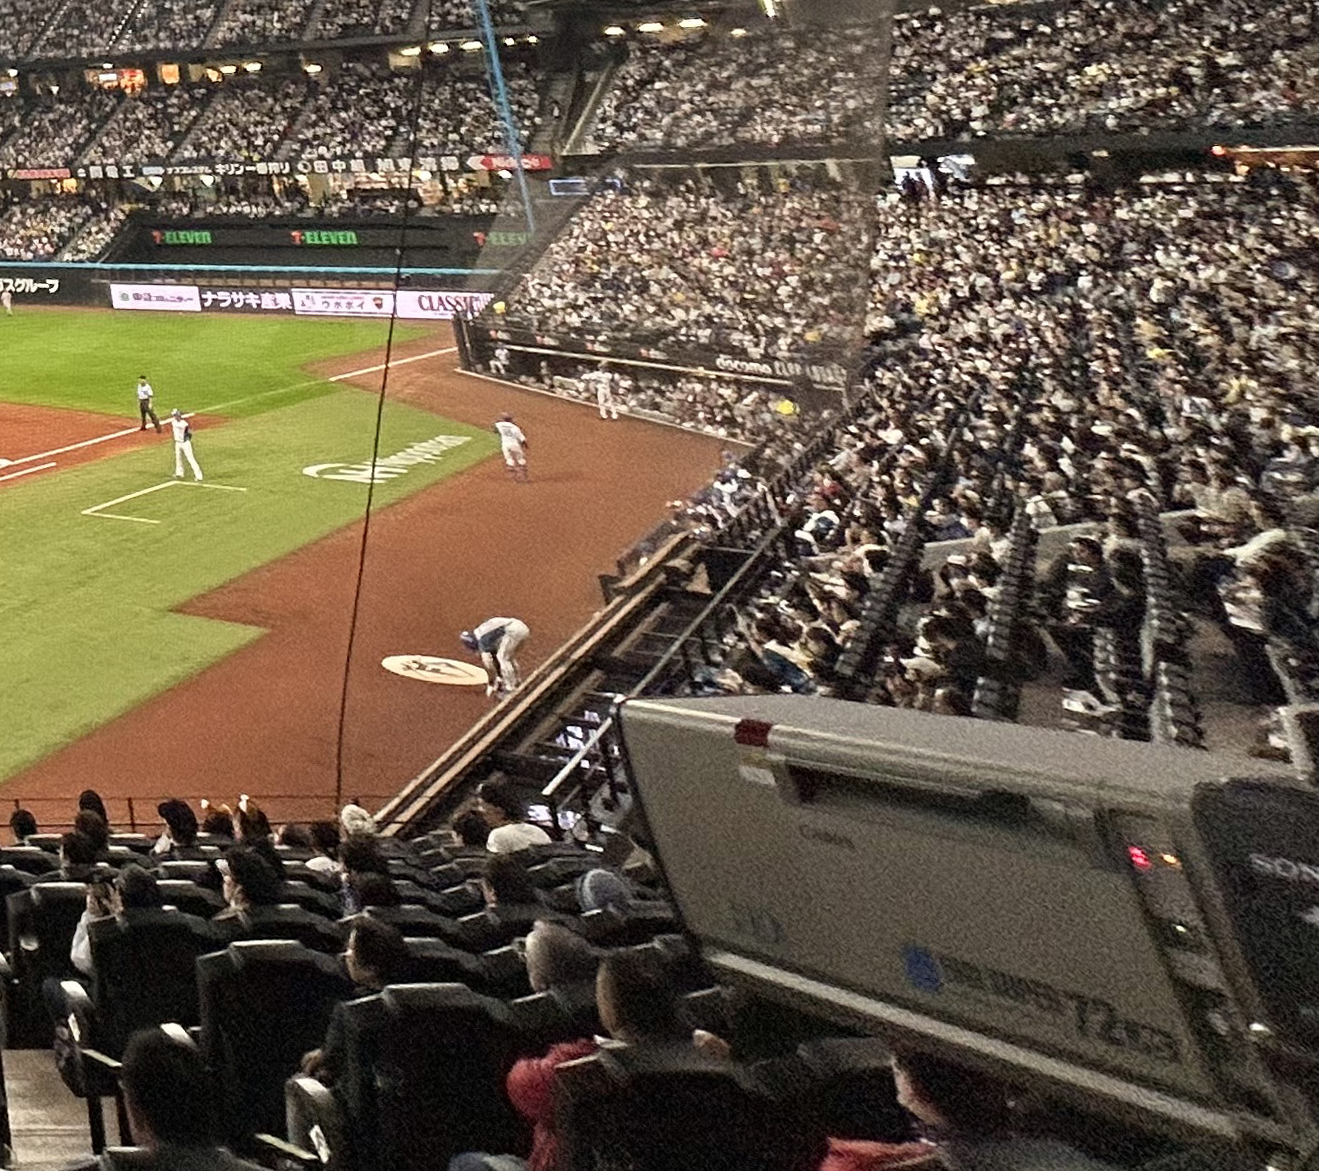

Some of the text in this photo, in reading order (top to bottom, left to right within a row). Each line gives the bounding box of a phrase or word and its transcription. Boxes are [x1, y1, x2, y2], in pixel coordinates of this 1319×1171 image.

[201, 292, 293, 310] ナラサキ産業
